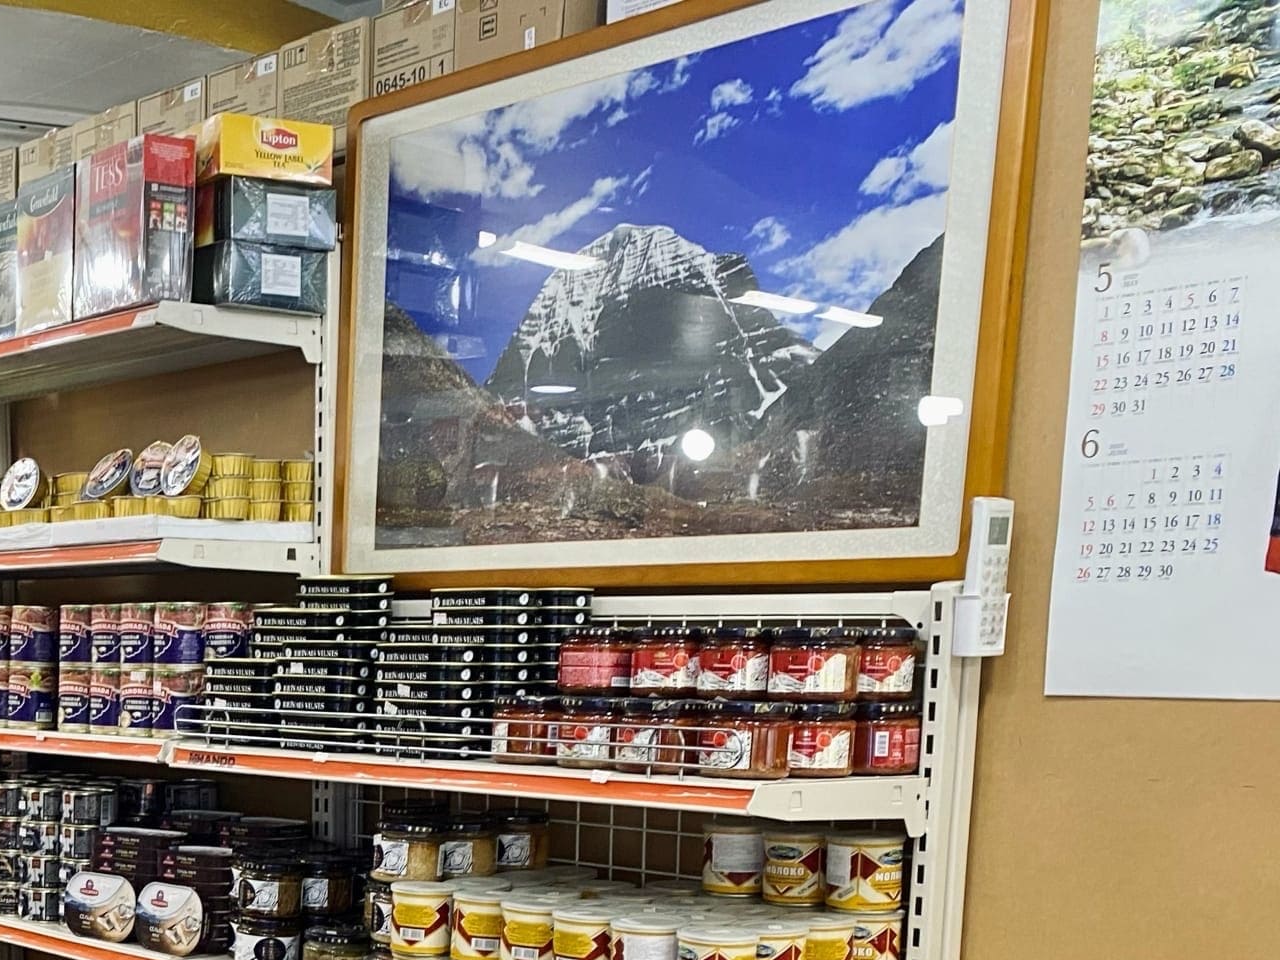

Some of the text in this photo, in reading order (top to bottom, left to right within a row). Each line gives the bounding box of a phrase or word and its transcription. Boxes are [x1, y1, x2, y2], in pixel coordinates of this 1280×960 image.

[376, 58, 446, 96] 0645-10 1
[262, 130, 296, 147] Lipton
[255, 150, 304, 164] YELLOW LABEL
[273, 160, 286, 168] TEA
[95, 160, 124, 193] TESS
[1094, 263, 1113, 292] 5
[1139, 325, 1153, 338] 10
[1160, 323, 1173, 335] 11
[1182, 319, 1196, 331] 12
[1204, 316, 1218, 329] 13
[1226, 314, 1239, 326] 14
[1096, 340, 1236, 368] 15 16 17 18 19 20 21
[1093, 365, 1235, 391] 22 23 24 25 26 27 28
[1092, 400, 1146, 416] 29 30 31
[1081, 429, 1100, 458] 6
